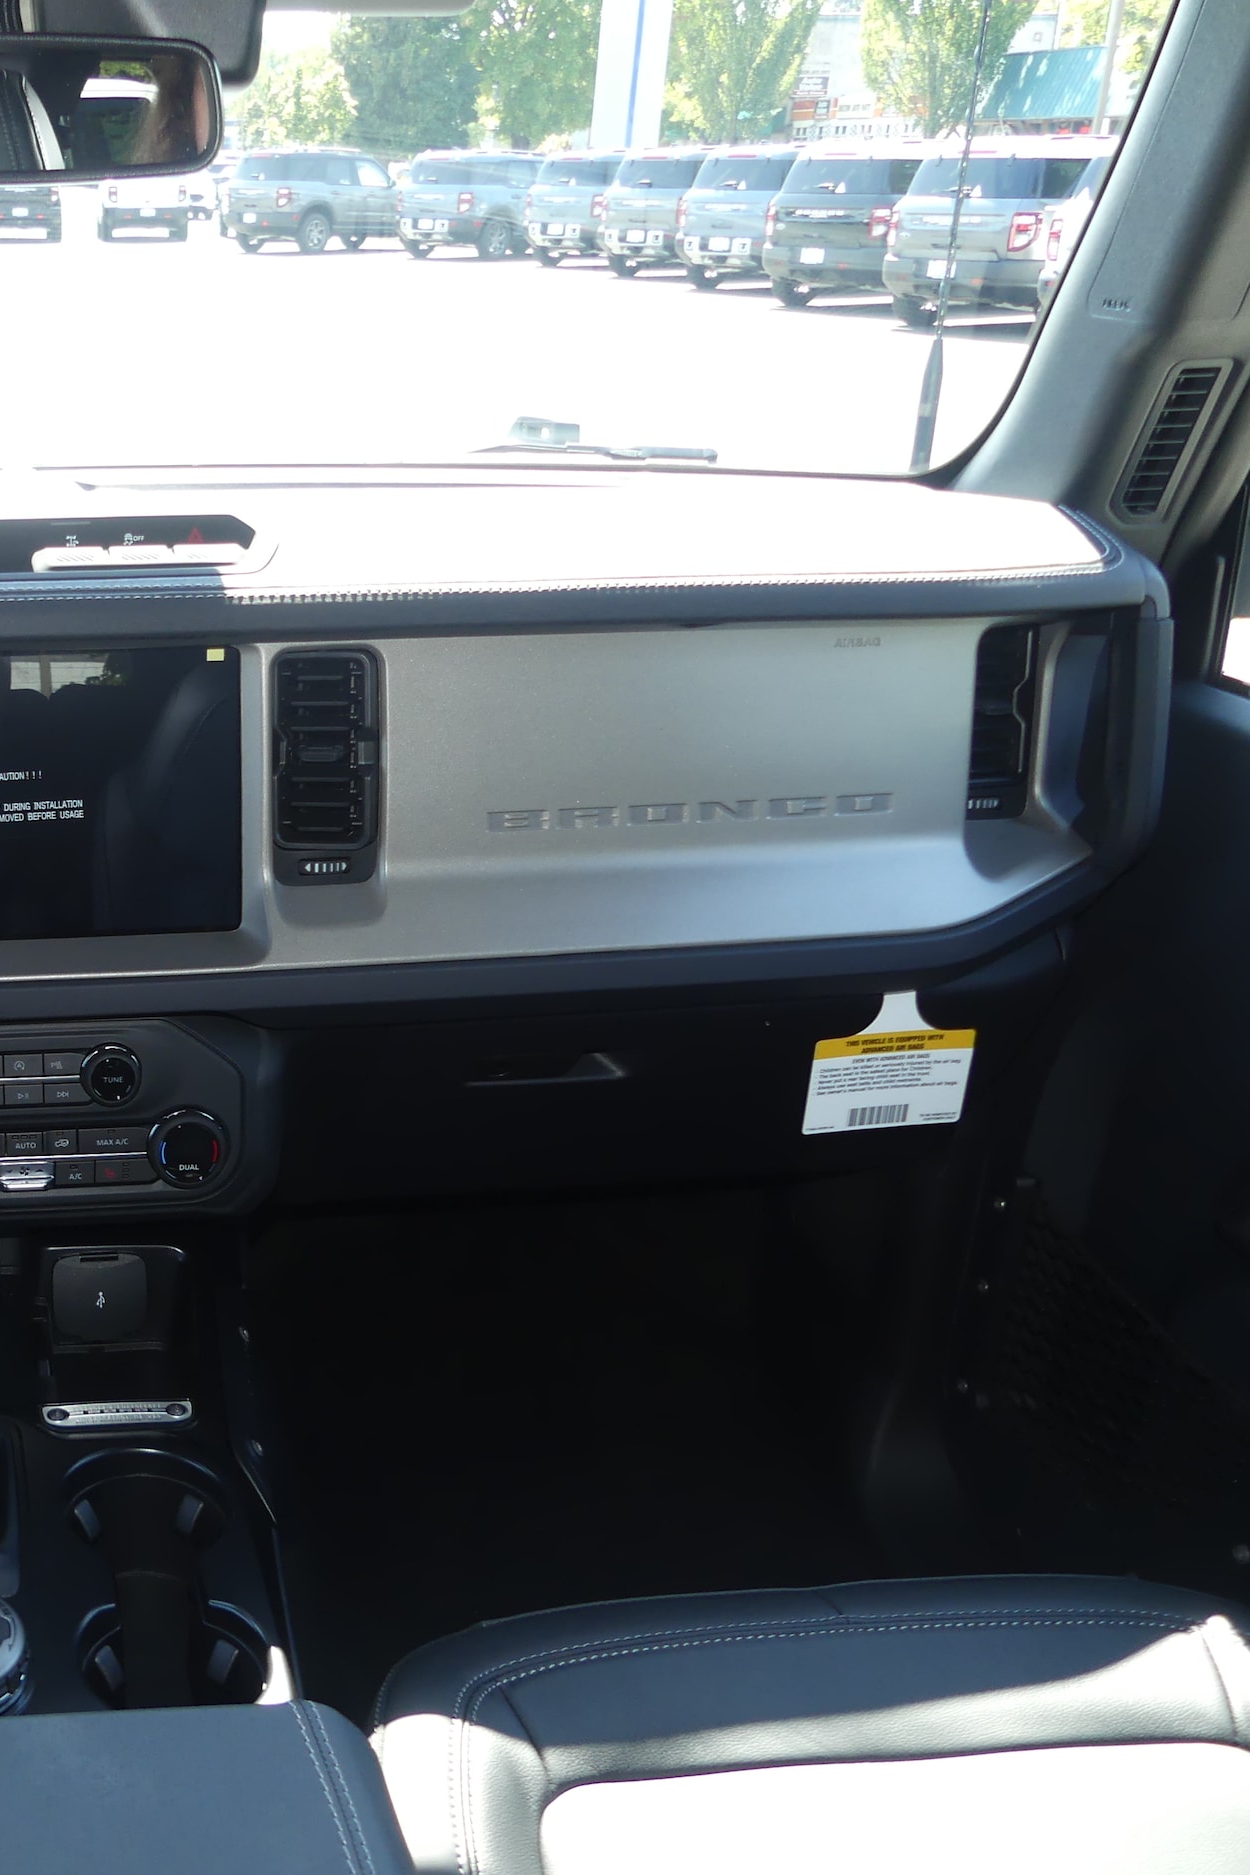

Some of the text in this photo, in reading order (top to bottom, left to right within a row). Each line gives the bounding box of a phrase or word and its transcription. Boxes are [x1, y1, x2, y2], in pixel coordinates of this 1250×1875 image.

[3, 802, 31, 812] DURING
[34, 800, 83, 810] INSTALLATION
[27, 811, 56, 821] BEFORE
[60, 810, 85, 819] USAGE
[485, 792, 893, 833] BRONCO
[861, 1037, 886, 1046] VEHICLE
[895, 1035, 926, 1043] EQUIPPED
[861, 1046, 894, 1054] ADVANCED
[103, 1076, 124, 1084] TUNE
[15, 1142, 37, 1150] AUTO
